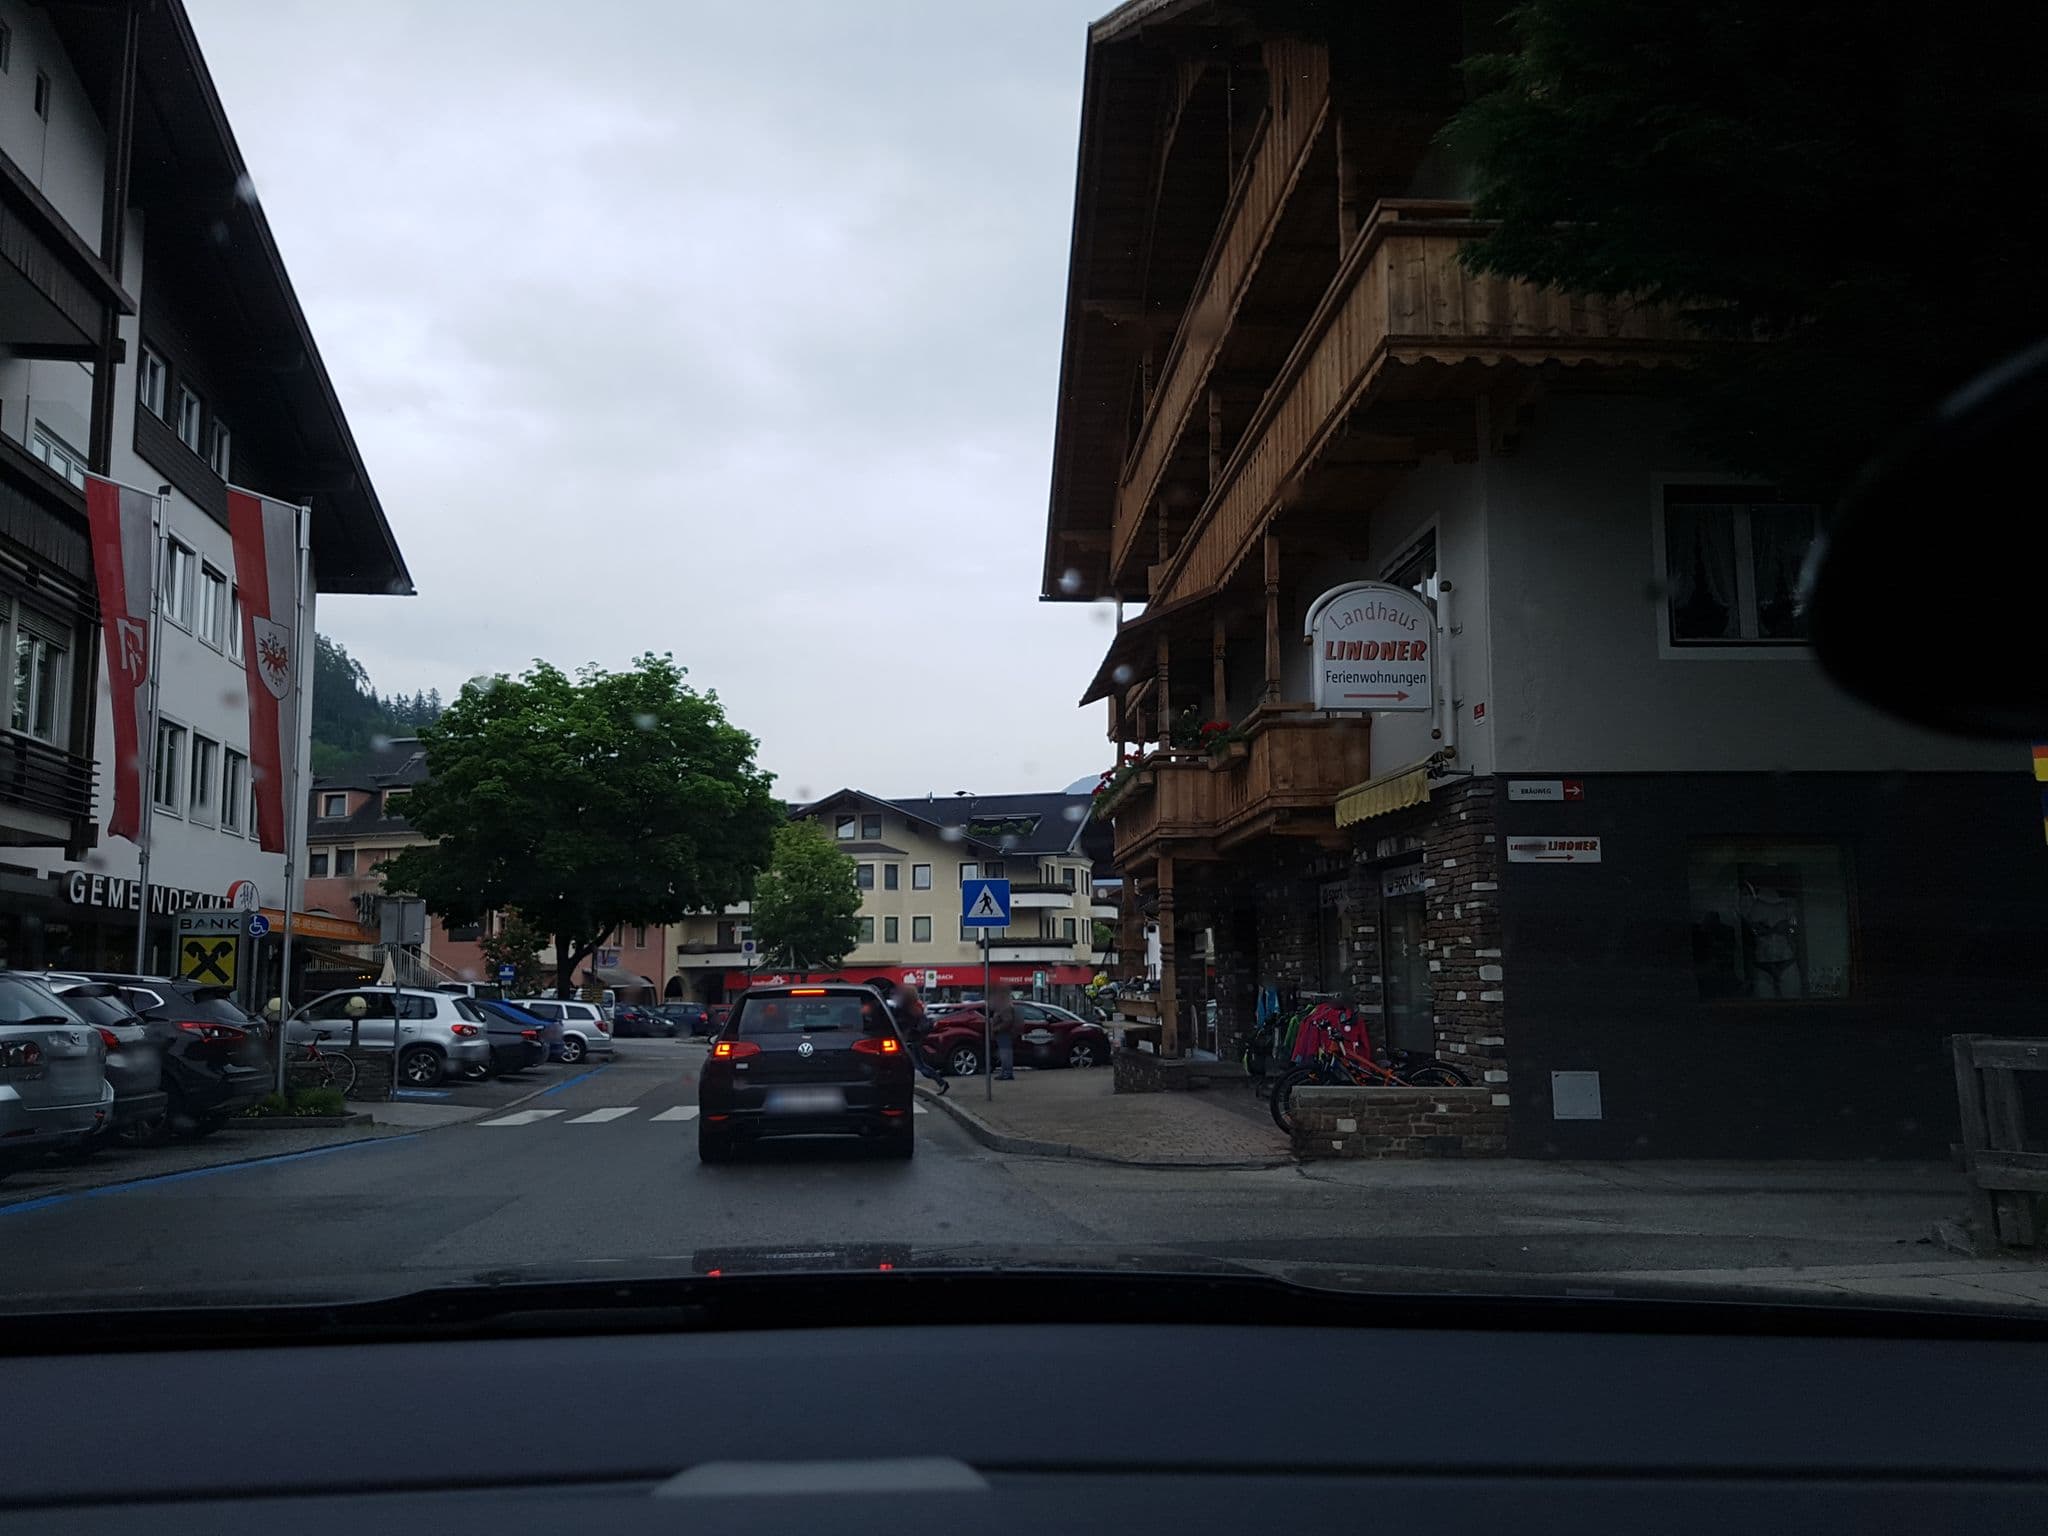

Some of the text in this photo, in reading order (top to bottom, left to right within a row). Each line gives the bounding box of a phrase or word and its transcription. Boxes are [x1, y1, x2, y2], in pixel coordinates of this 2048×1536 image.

[1330, 601, 1418, 631] Landhaus
[1325, 640, 1428, 662] LINDNER
[1326, 670, 1427, 687] Ferienwohnungen
[1548, 840, 1598, 851] LINDNER
[69, 870, 232, 915] GEMENDEAMT
[180, 918, 240, 930] BANK
